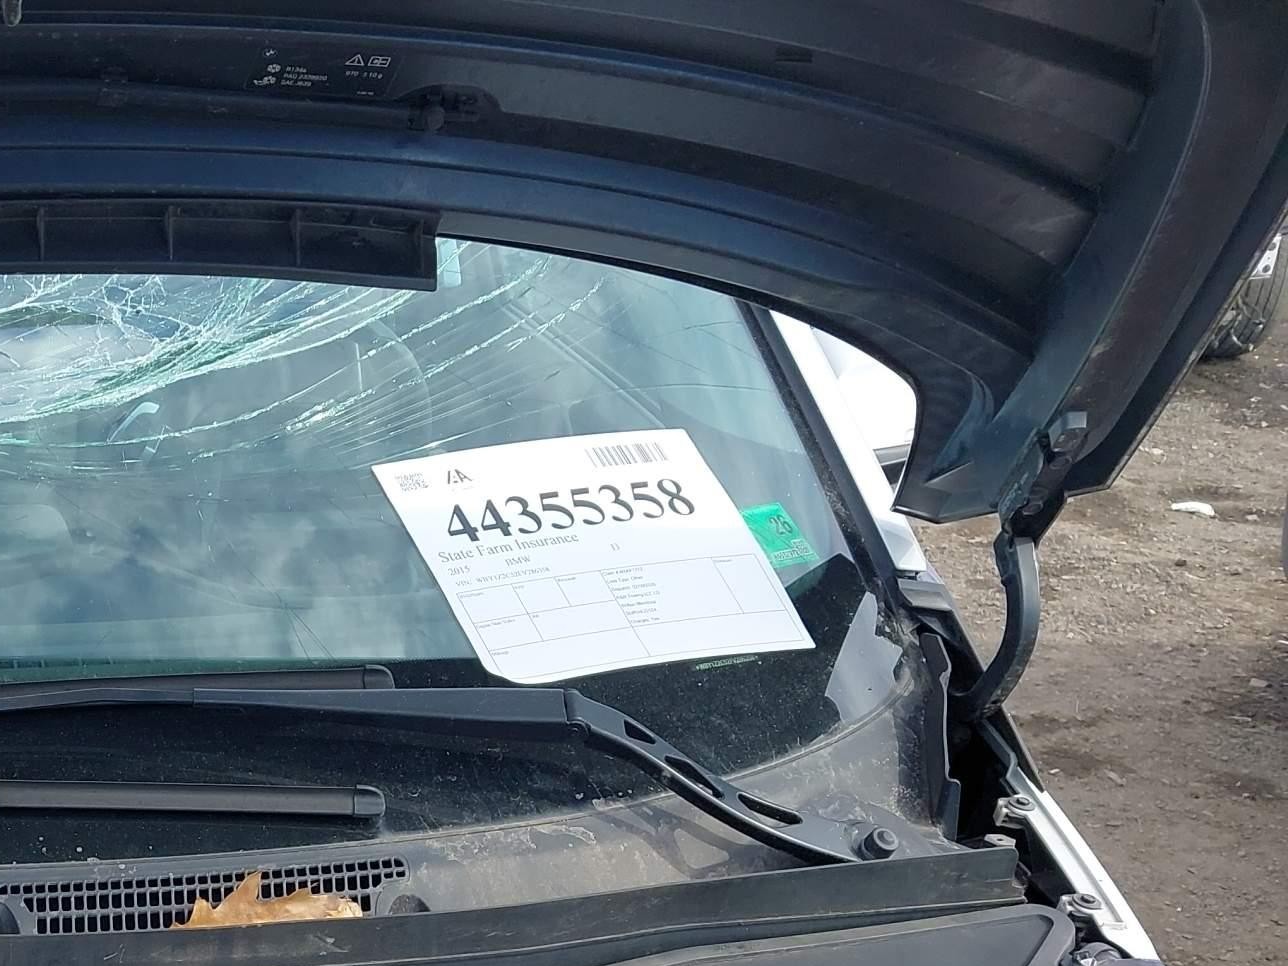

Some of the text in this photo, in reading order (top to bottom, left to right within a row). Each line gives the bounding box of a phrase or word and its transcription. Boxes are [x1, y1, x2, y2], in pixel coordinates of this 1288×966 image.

[446, 478, 696, 543] 44355358
[769, 514, 793, 536] 26
[438, 533, 579, 564] State Farm Insurance
[447, 565, 471, 577] 2015
